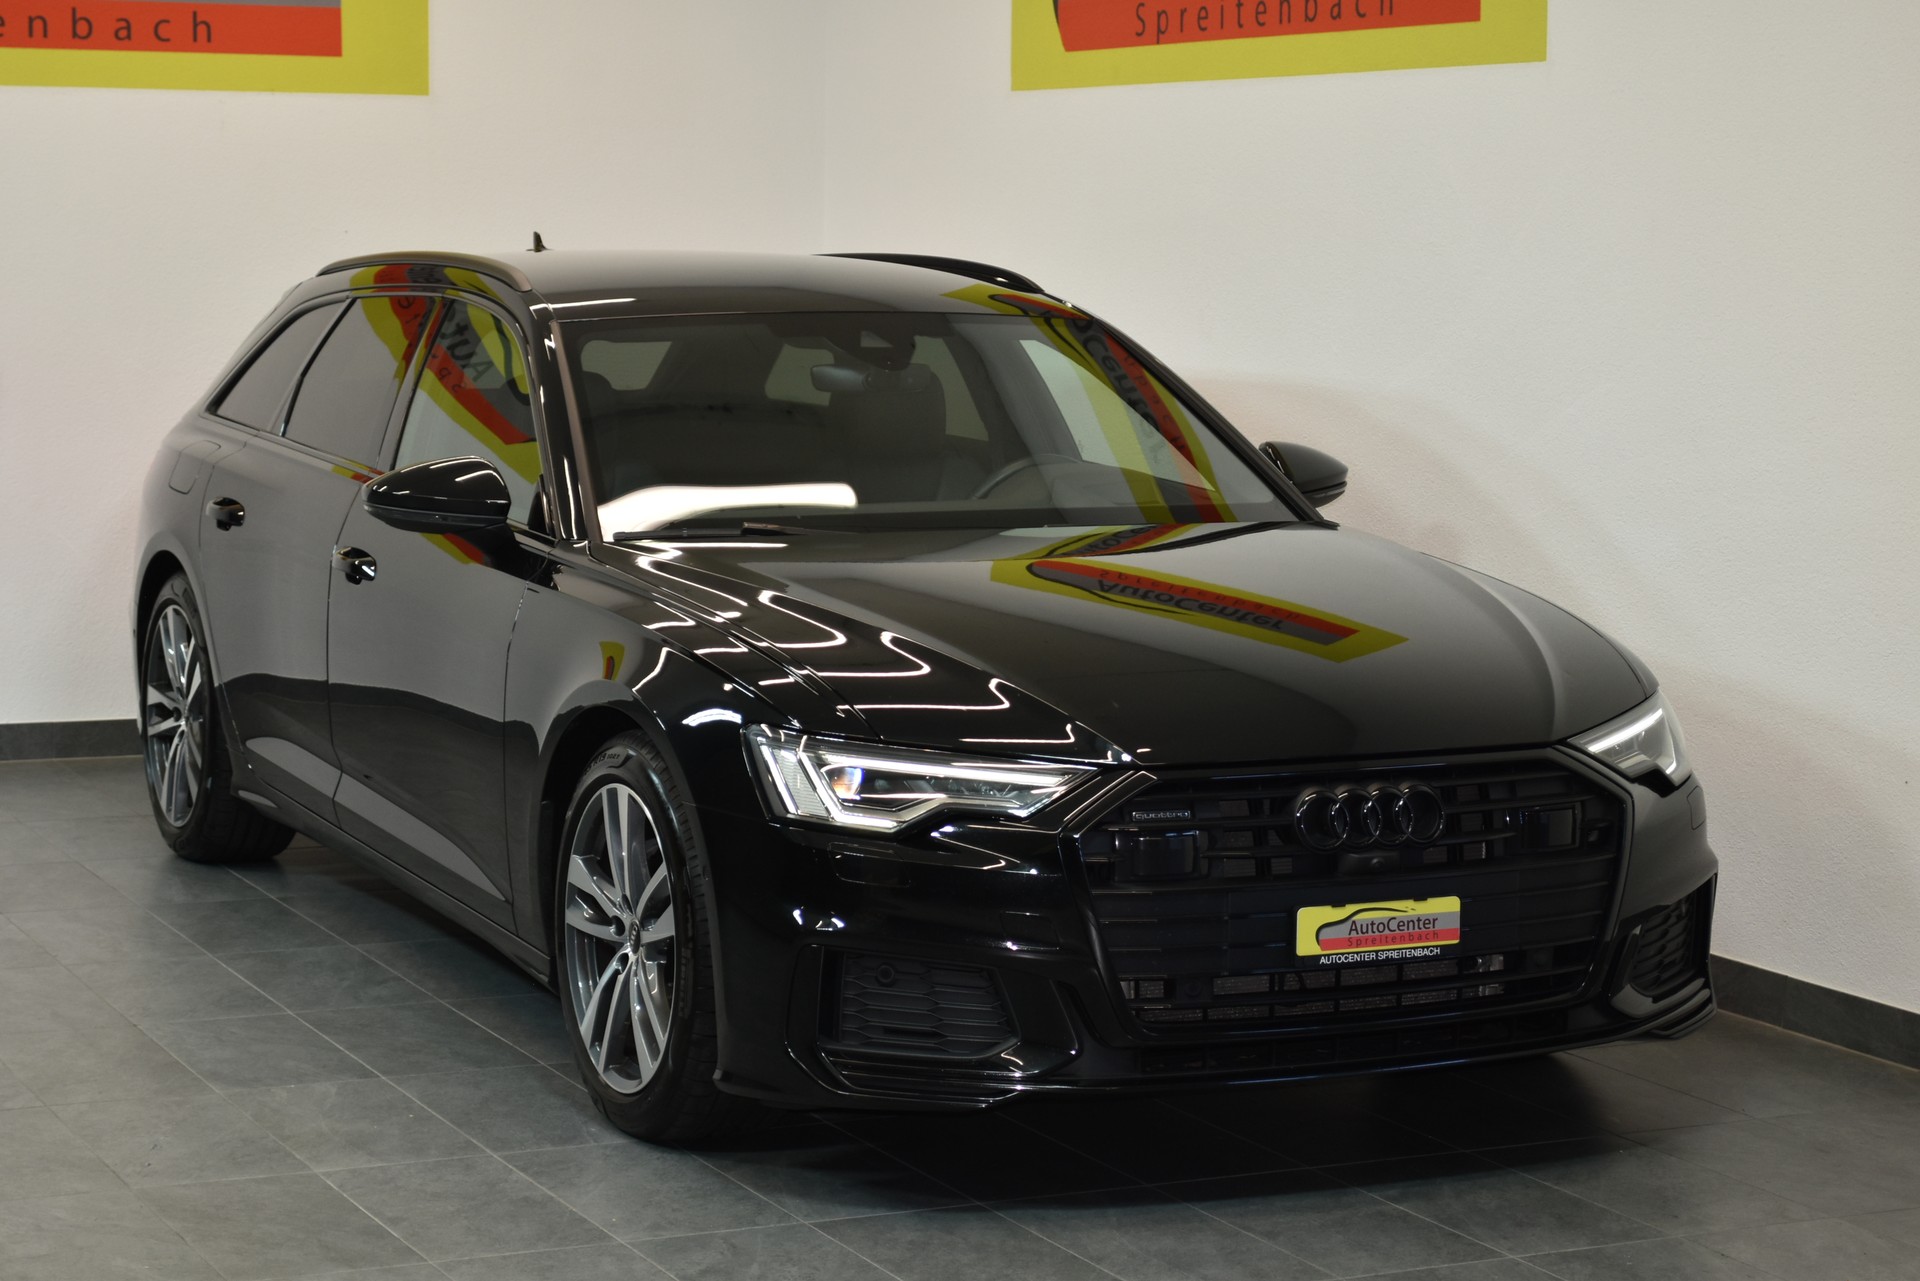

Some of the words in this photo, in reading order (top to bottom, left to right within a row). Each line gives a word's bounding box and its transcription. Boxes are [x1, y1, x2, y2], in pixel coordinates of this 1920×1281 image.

[1348, 917, 1439, 936] AutoCenter
[1348, 931, 1439, 948] Spreitenbach
[1320, 953, 1376, 965] AUTOCENTER
[1378, 947, 1441, 960] SPREITENBACH
